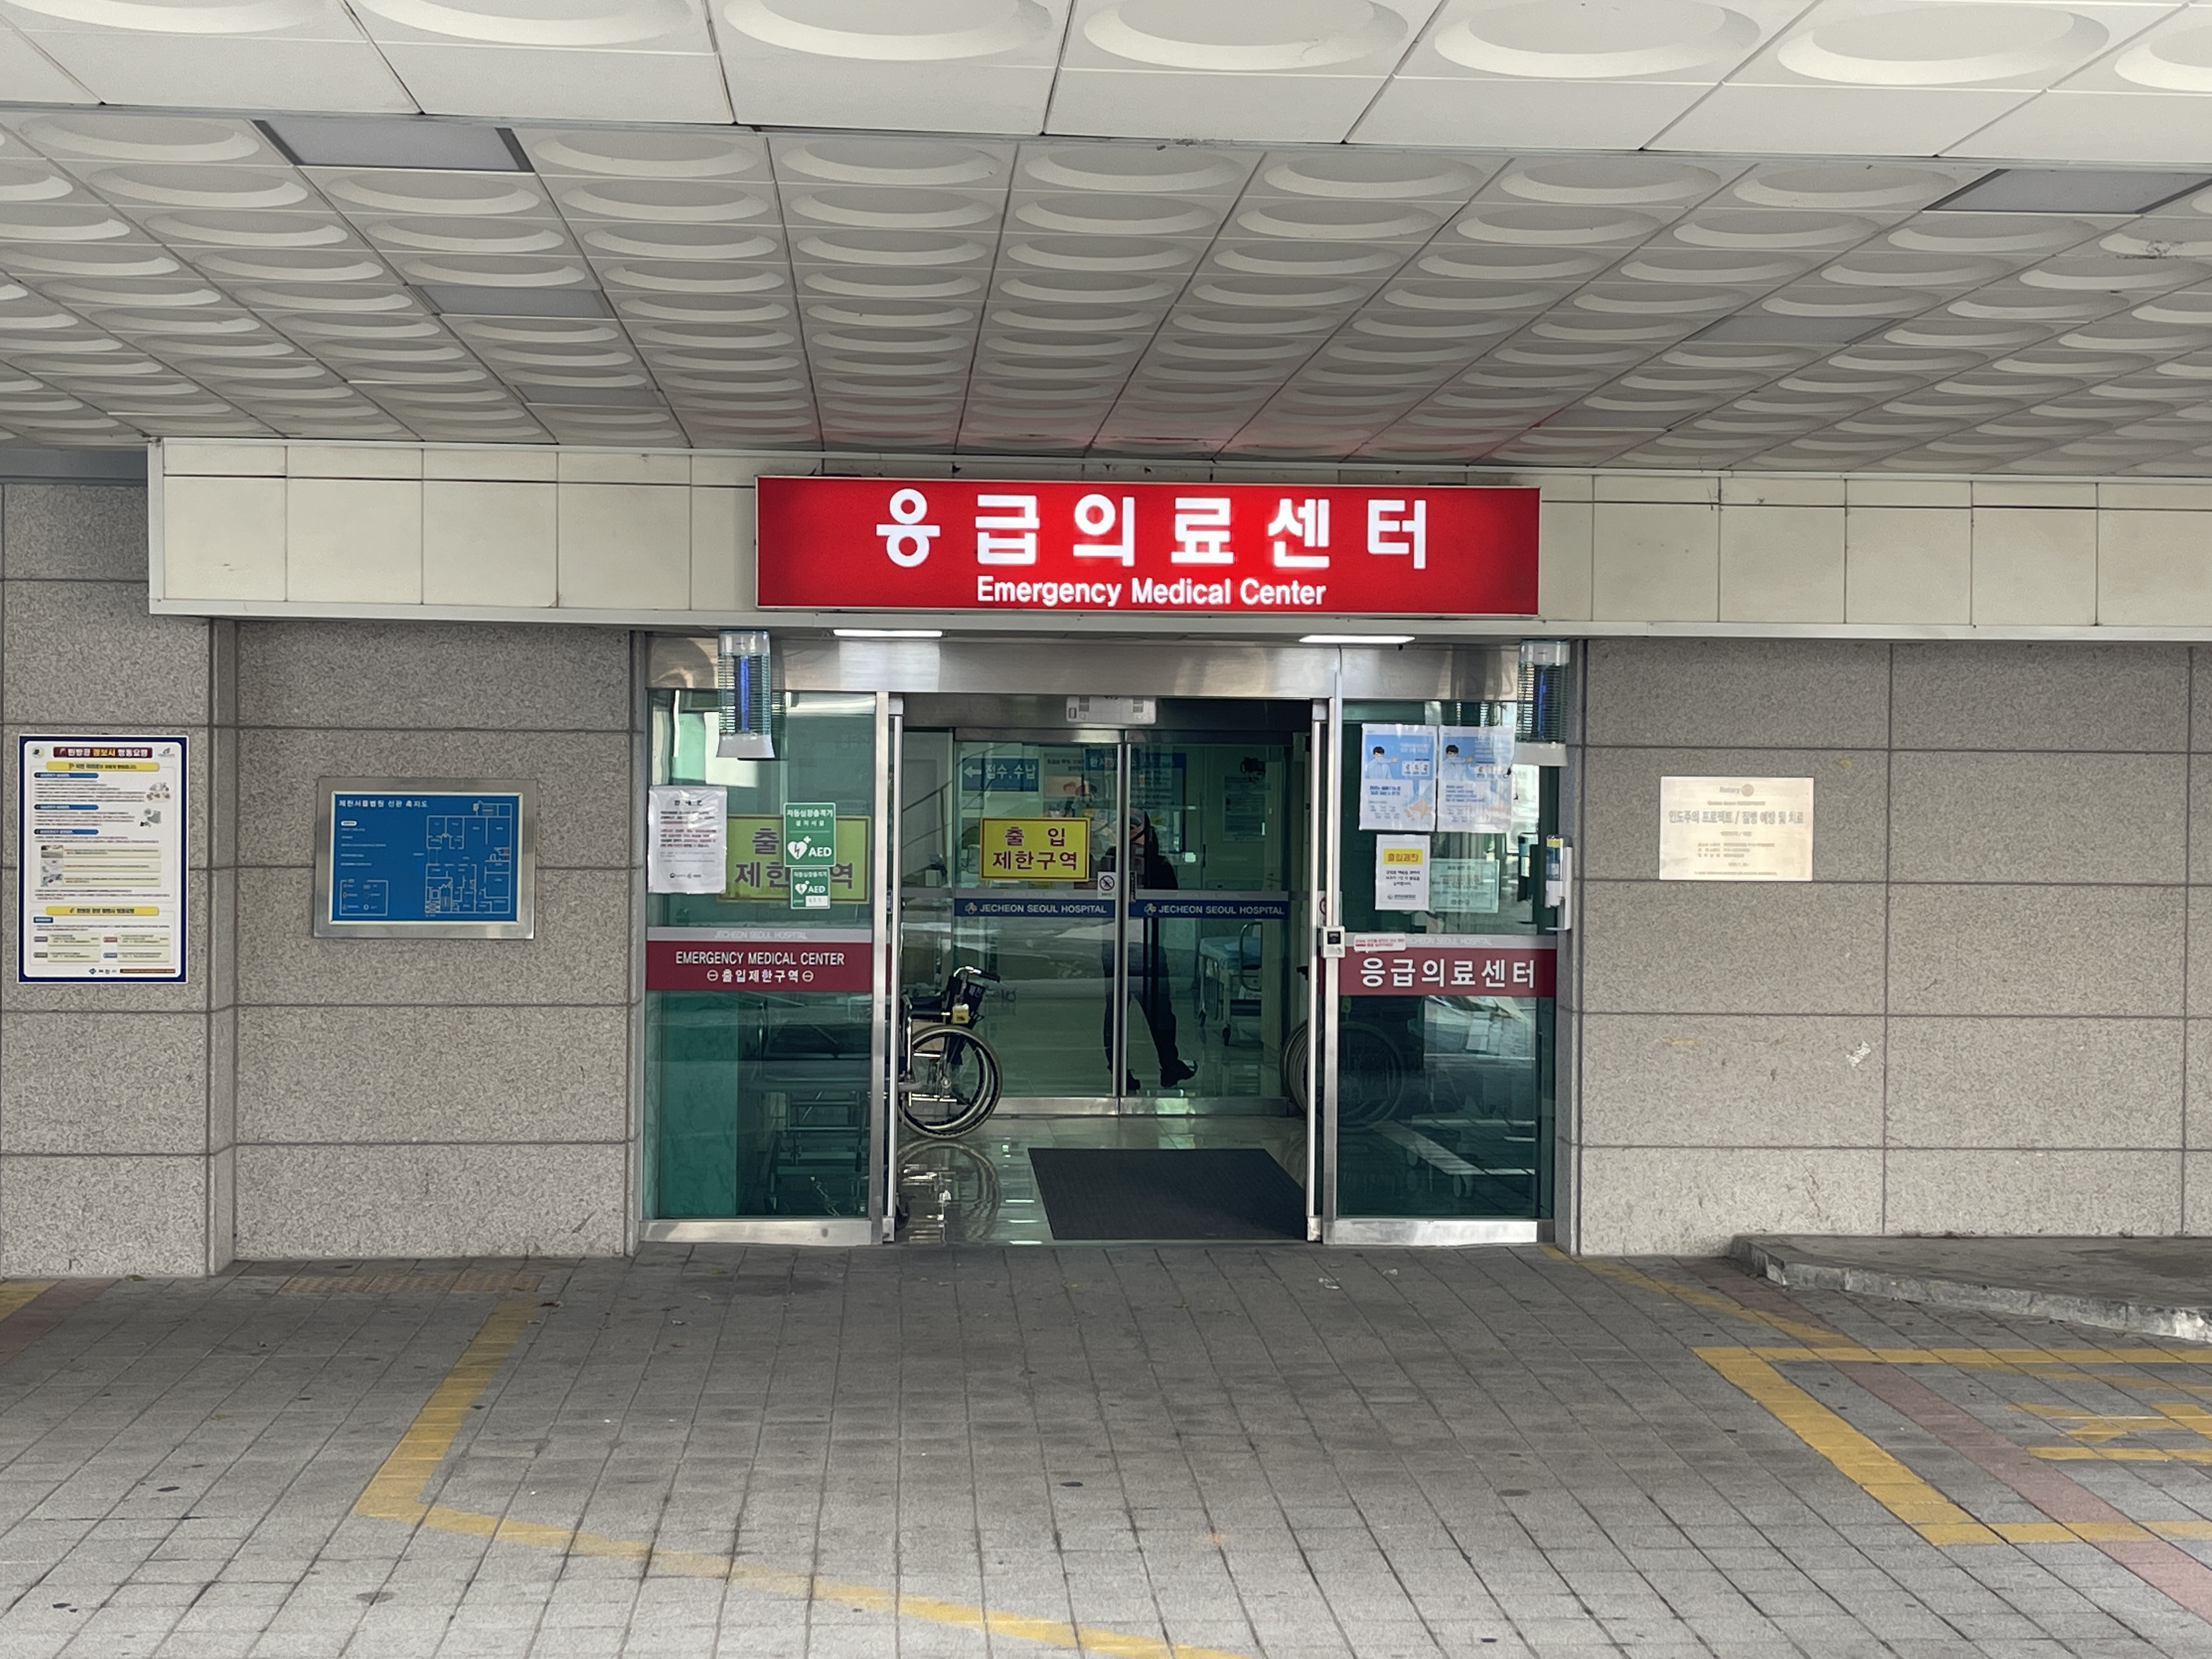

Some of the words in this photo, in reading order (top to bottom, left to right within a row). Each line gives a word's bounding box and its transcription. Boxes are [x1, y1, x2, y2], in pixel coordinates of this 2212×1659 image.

[876, 488, 1426, 569] 응급의료센터
[978, 575, 1122, 607] Emergency
[1132, 578, 1231, 605] Medical
[1240, 578, 1327, 605] Center
[1669, 810, 1700, 823] 인도주의
[1702, 810, 1734, 824] 프로젝트
[809, 847, 832, 857] AED
[992, 850, 1077, 871] 제한구역
[980, 904, 1024, 912] JECHEON
[1027, 905, 1058, 913] SEOUL
[1061, 905, 1107, 913] HOSPITAL
[1158, 905, 1203, 913] JECHEON
[1206, 906, 1236, 914] SEOUL
[1239, 906, 1285, 915] HOSPITAL
[714, 930, 747, 939] JECHEON
[749, 931, 772, 940] SEOUL
[775, 931, 808, 940] HOSPITAL
[676, 951, 744, 964] EMERGENCY
[748, 952, 797, 964] MEDICAL
[800, 952, 845, 965] CENTER
[722, 969, 798, 983] 출입제한구역
[1360, 957, 1534, 988] 응급의료센터
